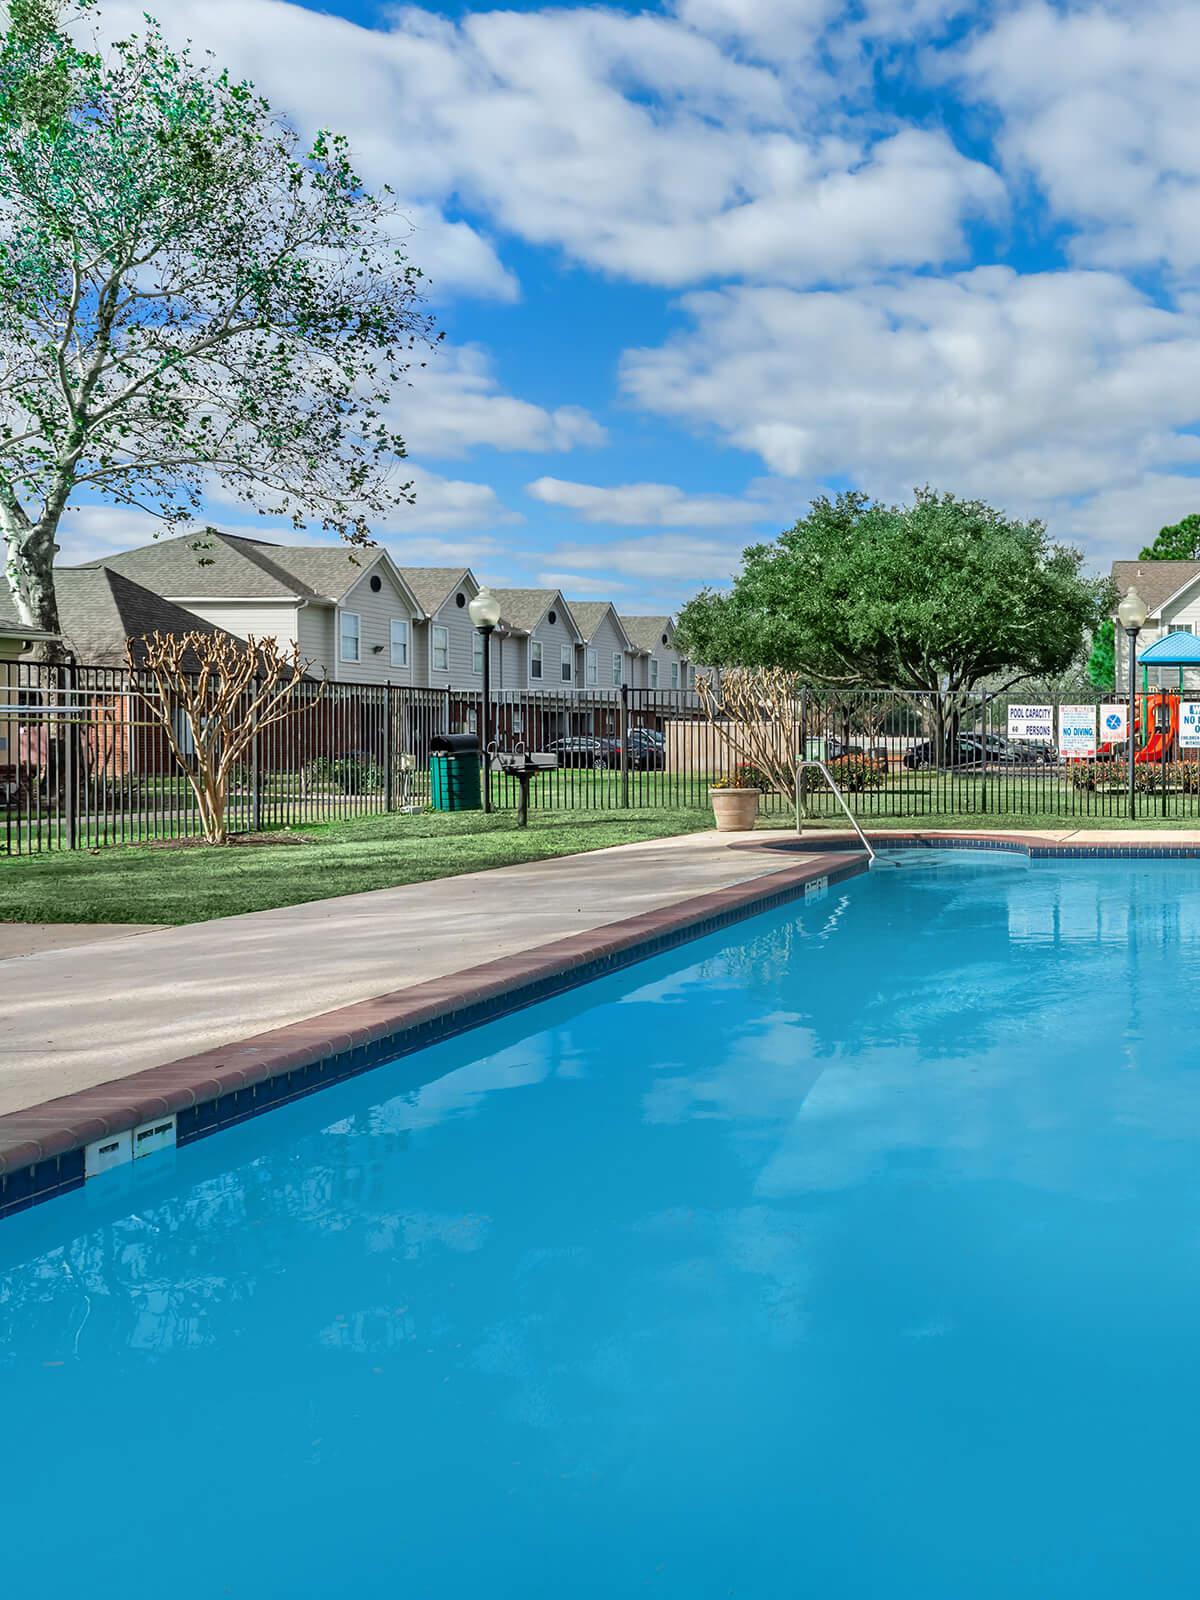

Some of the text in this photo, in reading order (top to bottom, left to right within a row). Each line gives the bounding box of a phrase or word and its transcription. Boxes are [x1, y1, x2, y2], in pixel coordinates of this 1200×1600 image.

[1010, 708, 1050, 718] POOL CAPACITY
[1184, 716, 1195, 724] NO
[1026, 726, 1050, 735] PERSONS
[1063, 728, 1071, 736] NO
